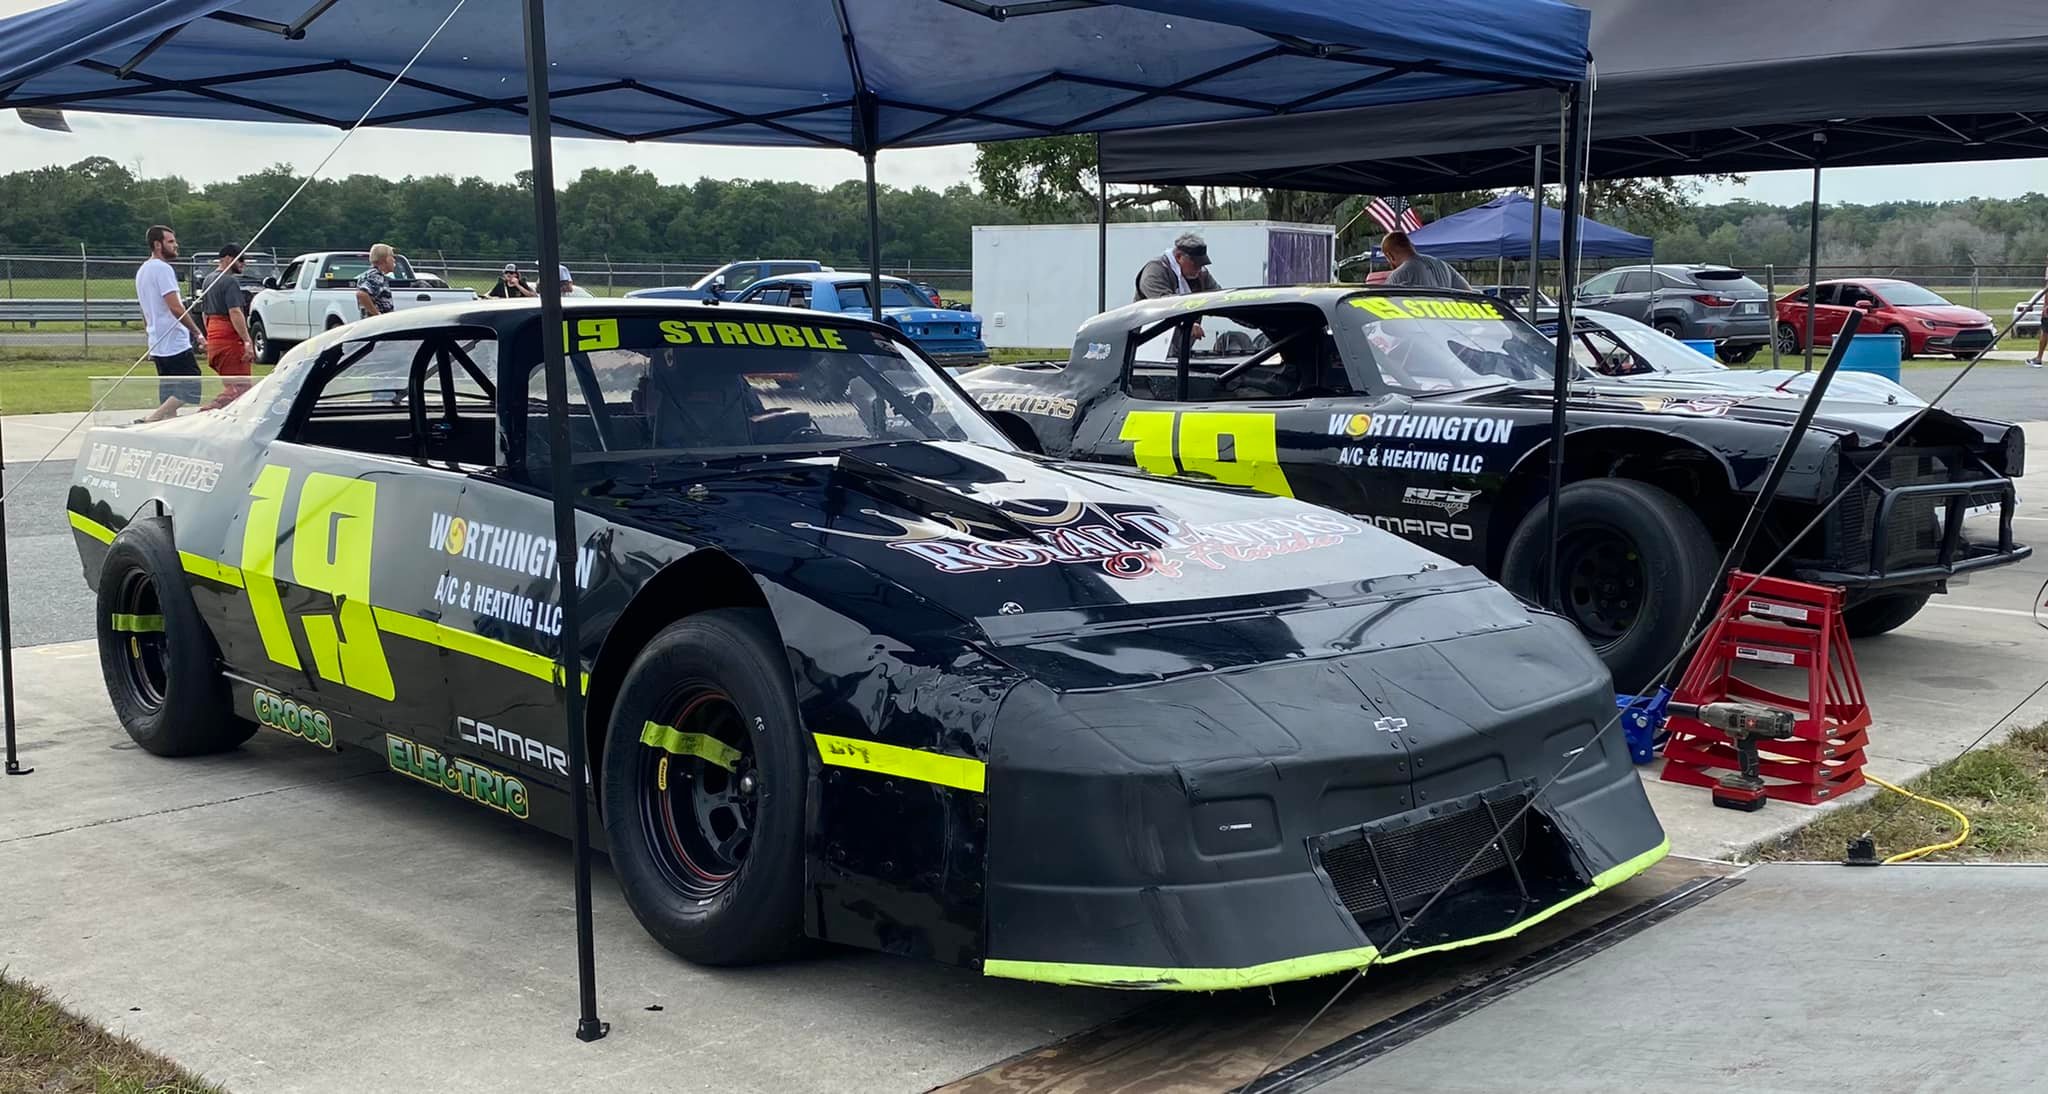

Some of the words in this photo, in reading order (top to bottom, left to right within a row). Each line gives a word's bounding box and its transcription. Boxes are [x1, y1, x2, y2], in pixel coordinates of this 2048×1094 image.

[659, 321, 848, 350] STRUBLE
[1349, 297, 1414, 319] 19
[1402, 300, 1504, 319] STRUBLE
[1328, 412, 1514, 443] WORTHINGTON
[147, 452, 224, 494] CHARTERS
[1338, 447, 1363, 466] A/C
[1367, 448, 1378, 466] &
[1382, 449, 1449, 472] HEATING
[1452, 454, 1483, 474] LLC
[429, 512, 594, 589] WORTHINGTN
[886, 525, 1156, 574] ROYAL
[241, 463, 396, 701] 19
[434, 574, 459, 605] A/C
[460, 581, 471, 609] &
[473, 585, 534, 628] HEATING
[535, 602, 563, 636] LLC
[253, 687, 334, 749] CROSS
[386, 732, 529, 820] ELECTRIC
[457, 716, 590, 784] CAMAR
